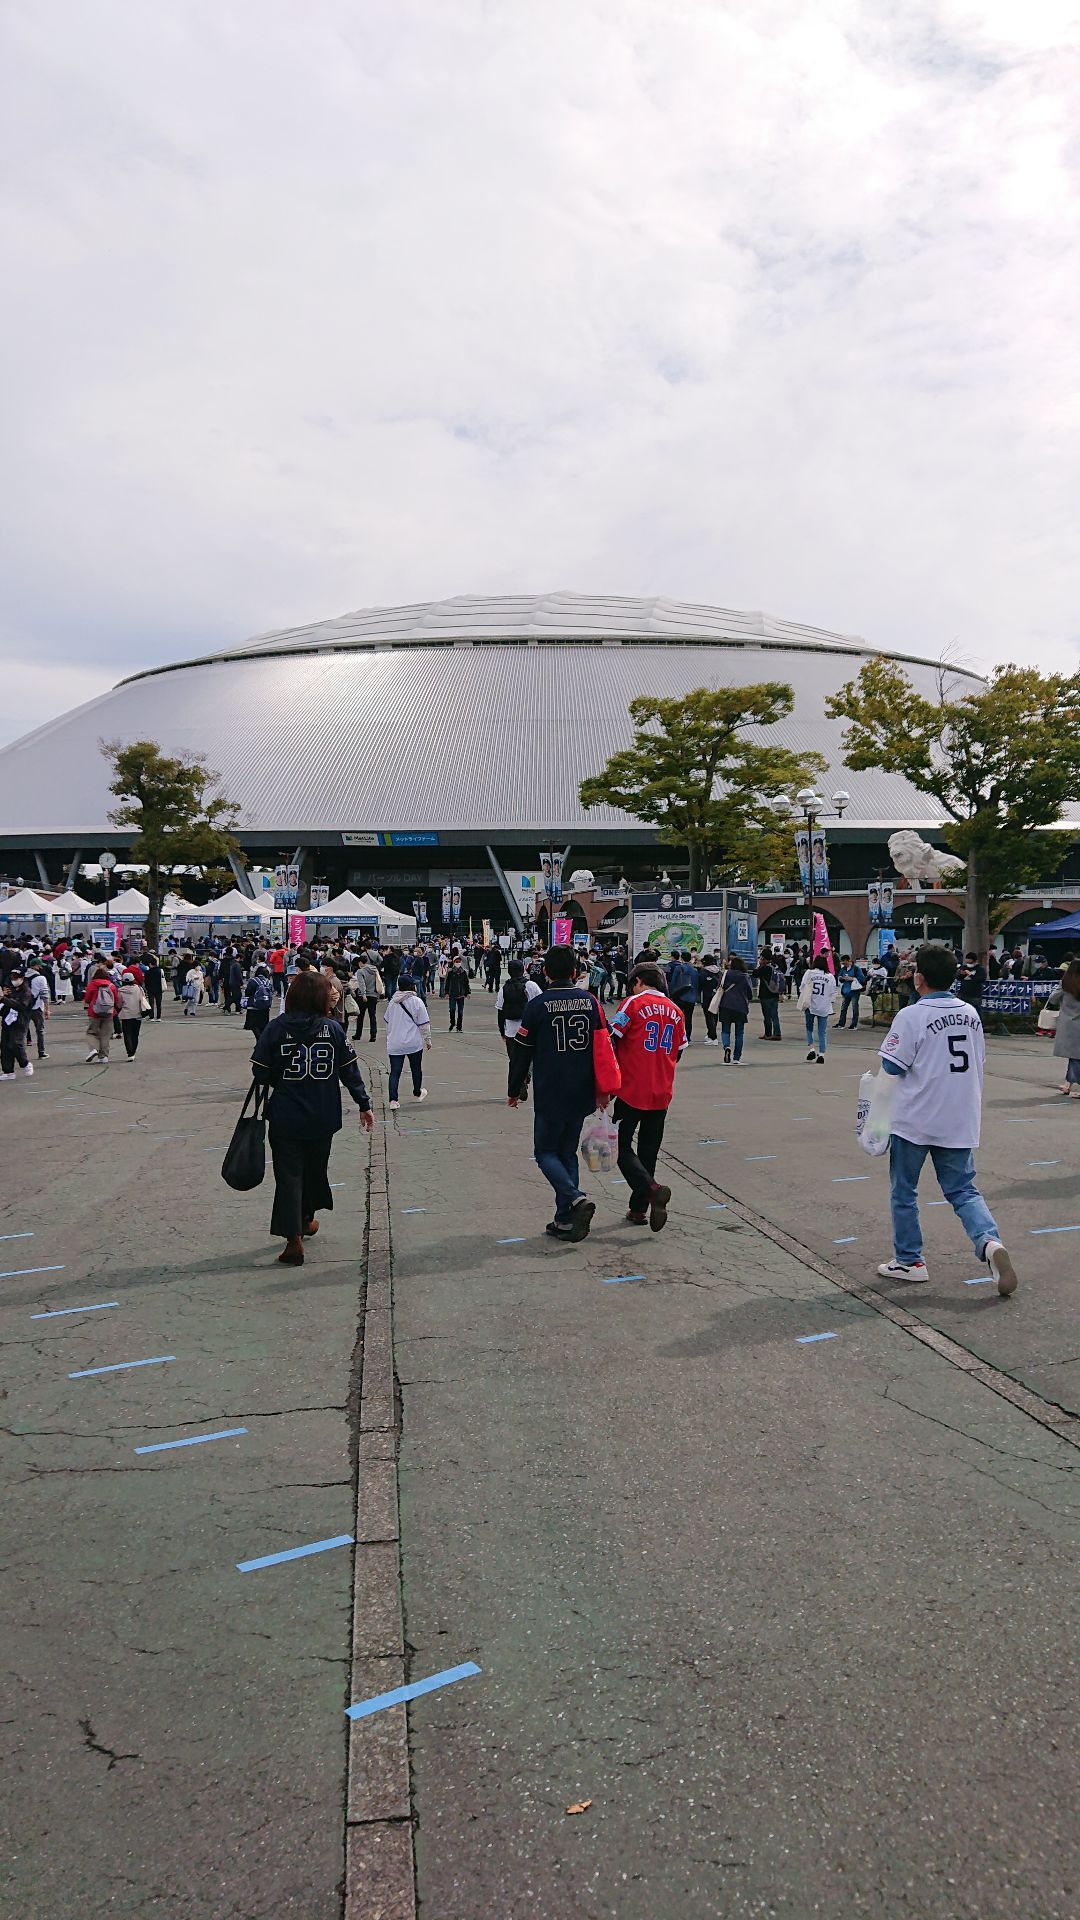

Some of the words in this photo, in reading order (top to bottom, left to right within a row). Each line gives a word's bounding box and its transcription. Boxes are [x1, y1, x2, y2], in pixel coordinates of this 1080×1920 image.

[403, 872, 423, 881] DAY
[812, 982, 825, 996] 51
[638, 1003, 681, 1025] YOSHIDA
[926, 1013, 981, 1034] TONOSAKI
[552, 1014, 590, 1052] 13
[643, 1020, 675, 1054] 34
[281, 1042, 335, 1080] 38
[947, 1035, 970, 1073] 5
